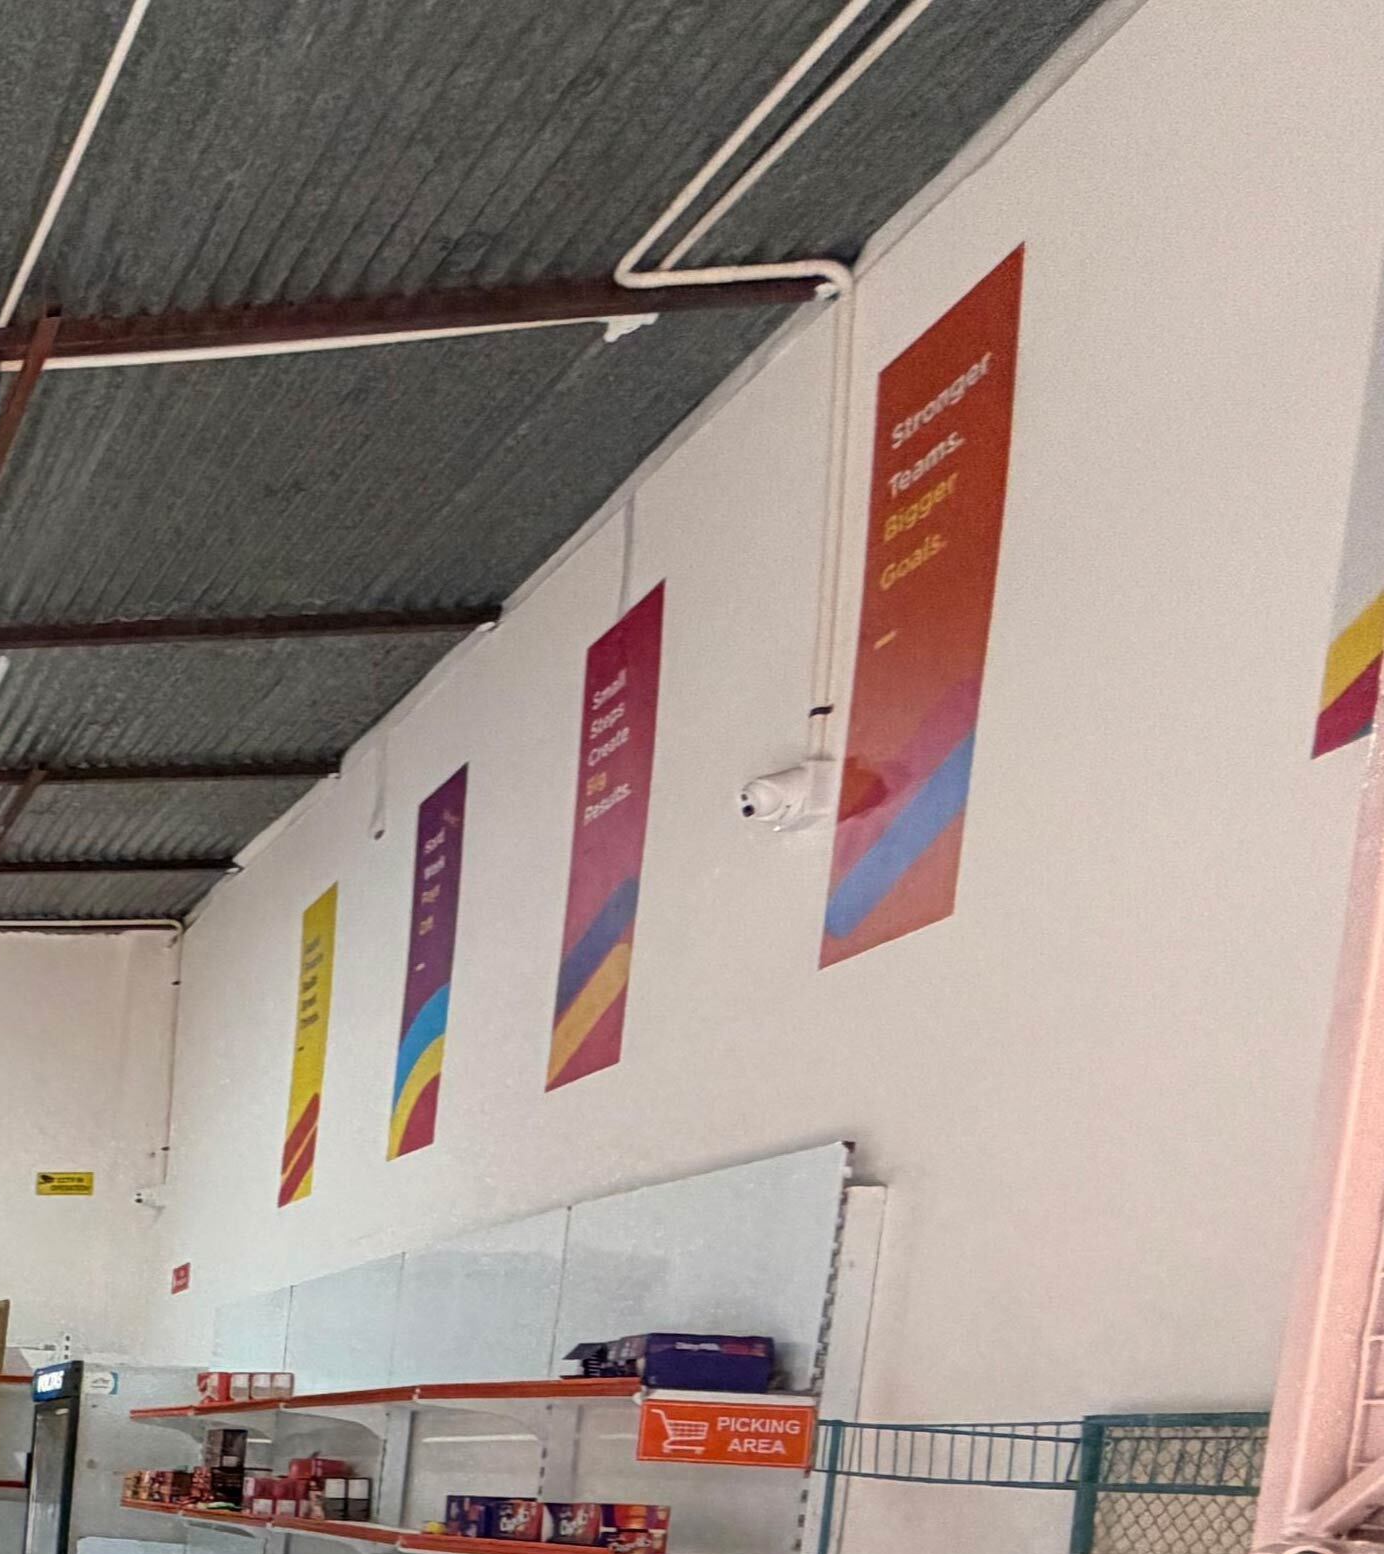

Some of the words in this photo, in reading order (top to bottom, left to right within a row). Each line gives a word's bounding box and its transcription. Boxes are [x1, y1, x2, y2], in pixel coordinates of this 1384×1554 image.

[891, 351, 993, 449] Stronger
[888, 431, 966, 499] Teams.
[884, 471, 959, 542] Bigger
[880, 534, 948, 590] Goals.
[586, 726, 631, 767] Create
[717, 1416, 801, 1435] PICKING
[727, 1438, 787, 1455] AREA
